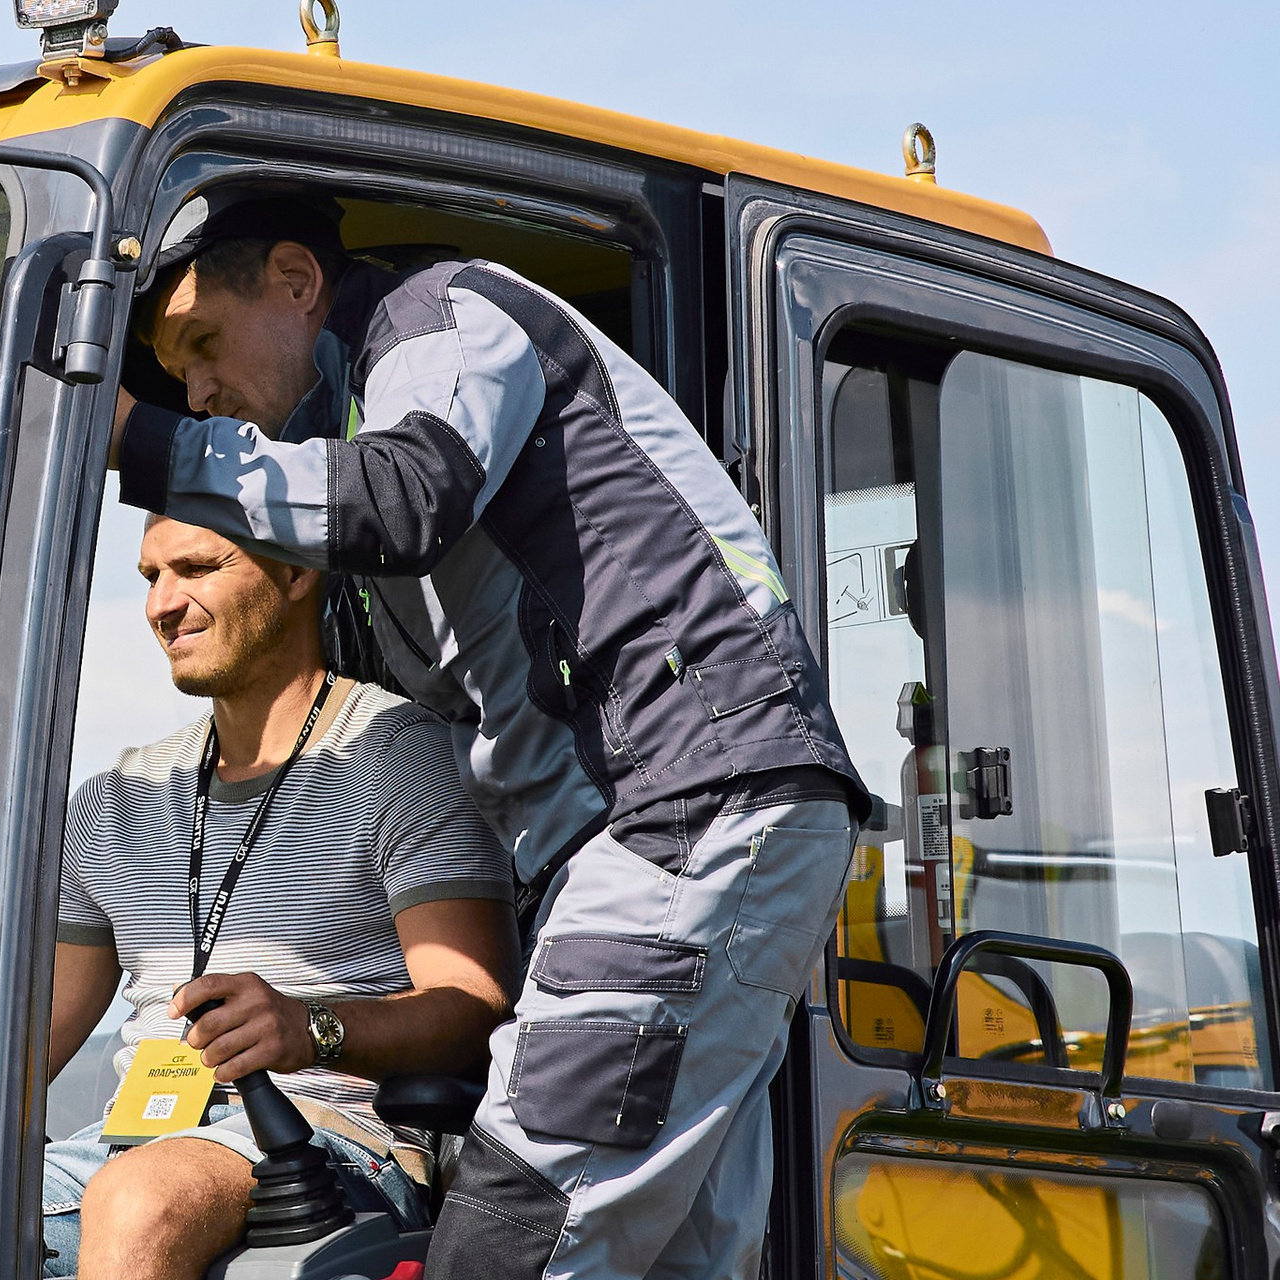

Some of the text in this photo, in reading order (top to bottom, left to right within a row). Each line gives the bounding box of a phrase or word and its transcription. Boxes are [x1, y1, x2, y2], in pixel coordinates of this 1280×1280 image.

[193, 795, 205, 850] SHANTUI
[201, 891, 229, 953] SHANTUI
[147, 1067, 200, 1078] ROAD SHOW
